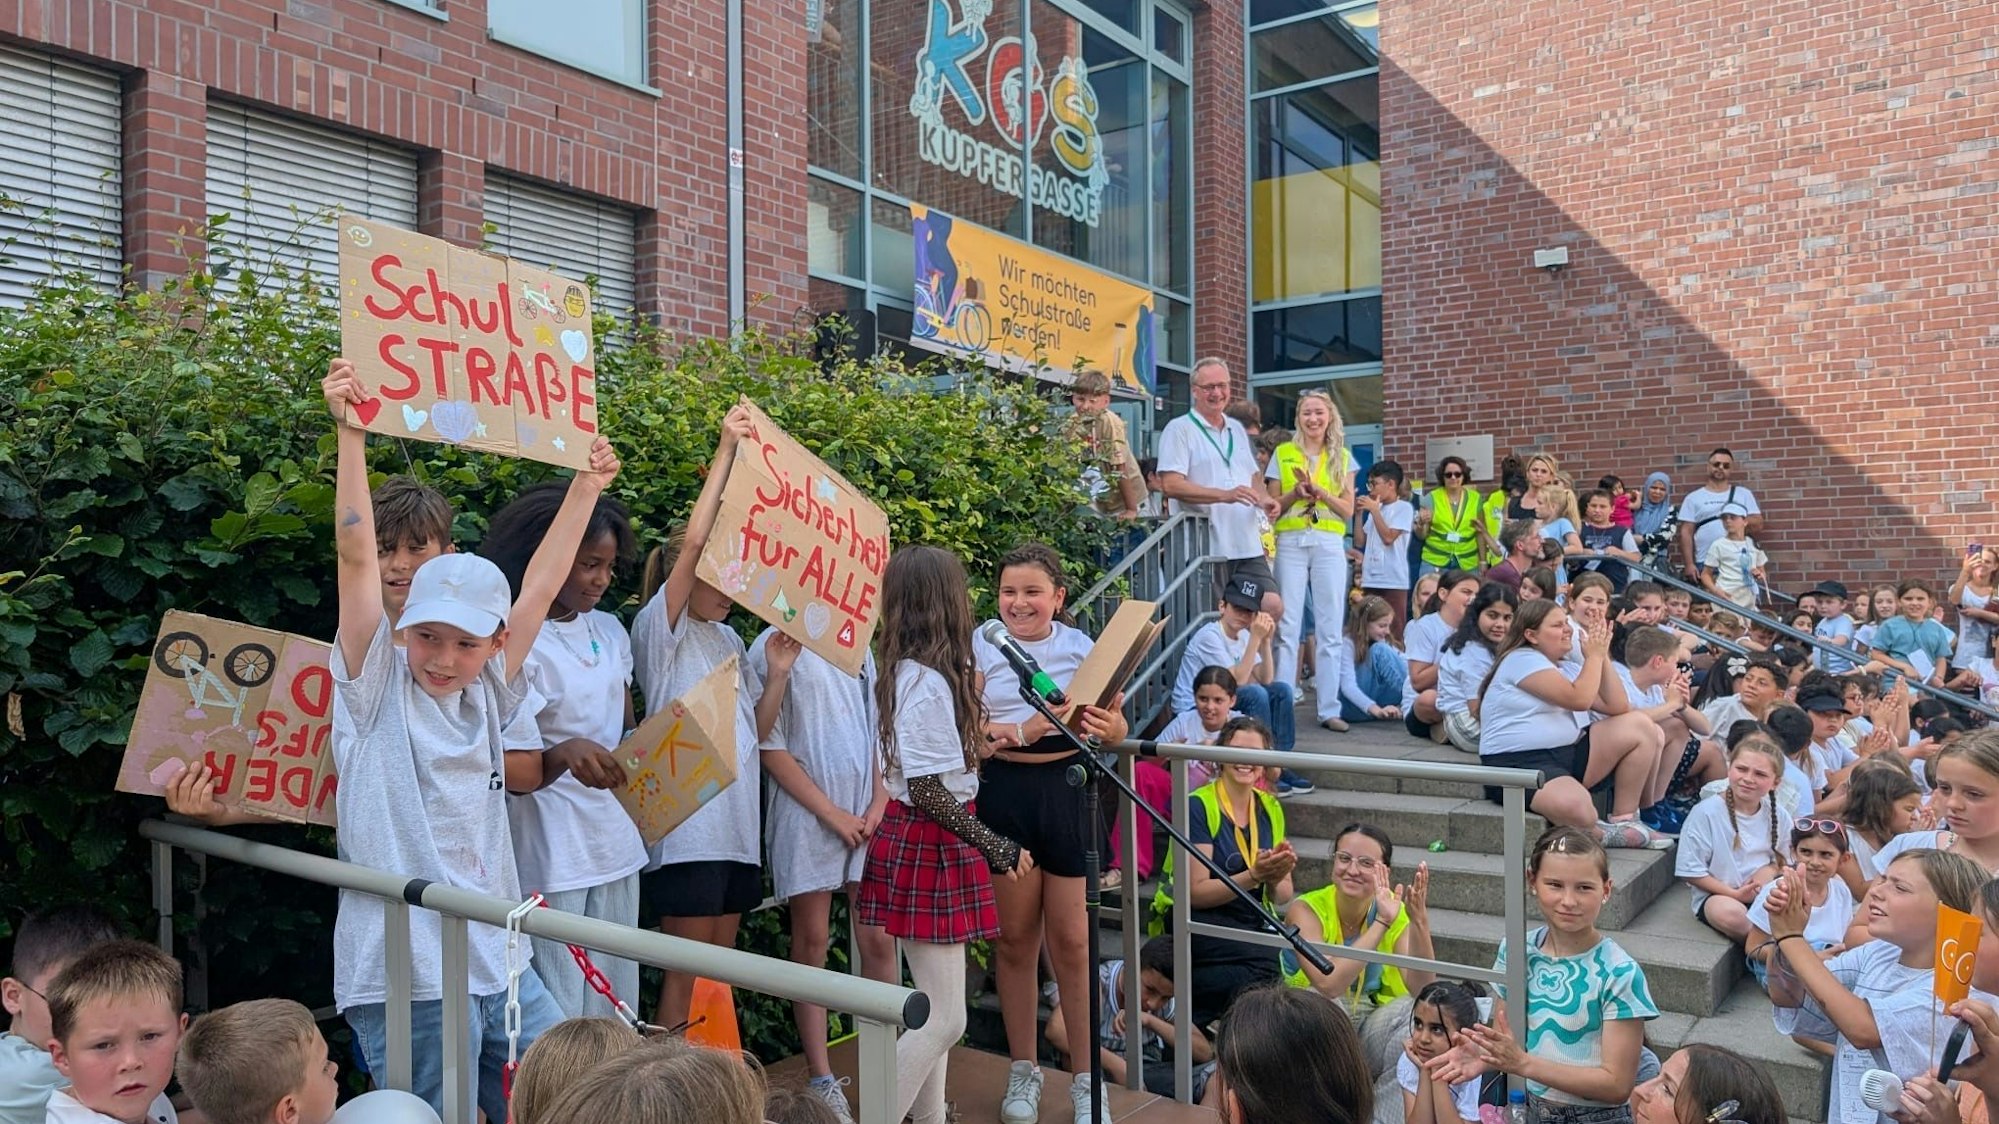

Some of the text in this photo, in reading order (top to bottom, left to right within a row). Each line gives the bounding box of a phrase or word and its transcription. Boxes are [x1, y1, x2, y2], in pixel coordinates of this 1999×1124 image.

[921, 117, 1100, 227] KUPFERGASSE
[364, 254, 524, 347] Schul
[998, 254, 1096, 308] Wir möchten
[999, 284, 1091, 332] Schulstraße
[1001, 317, 1061, 350] werden!
[756, 443, 888, 576] Sicherheit
[798, 545, 876, 624] ALLE
[1241, 581, 1257, 598] M
